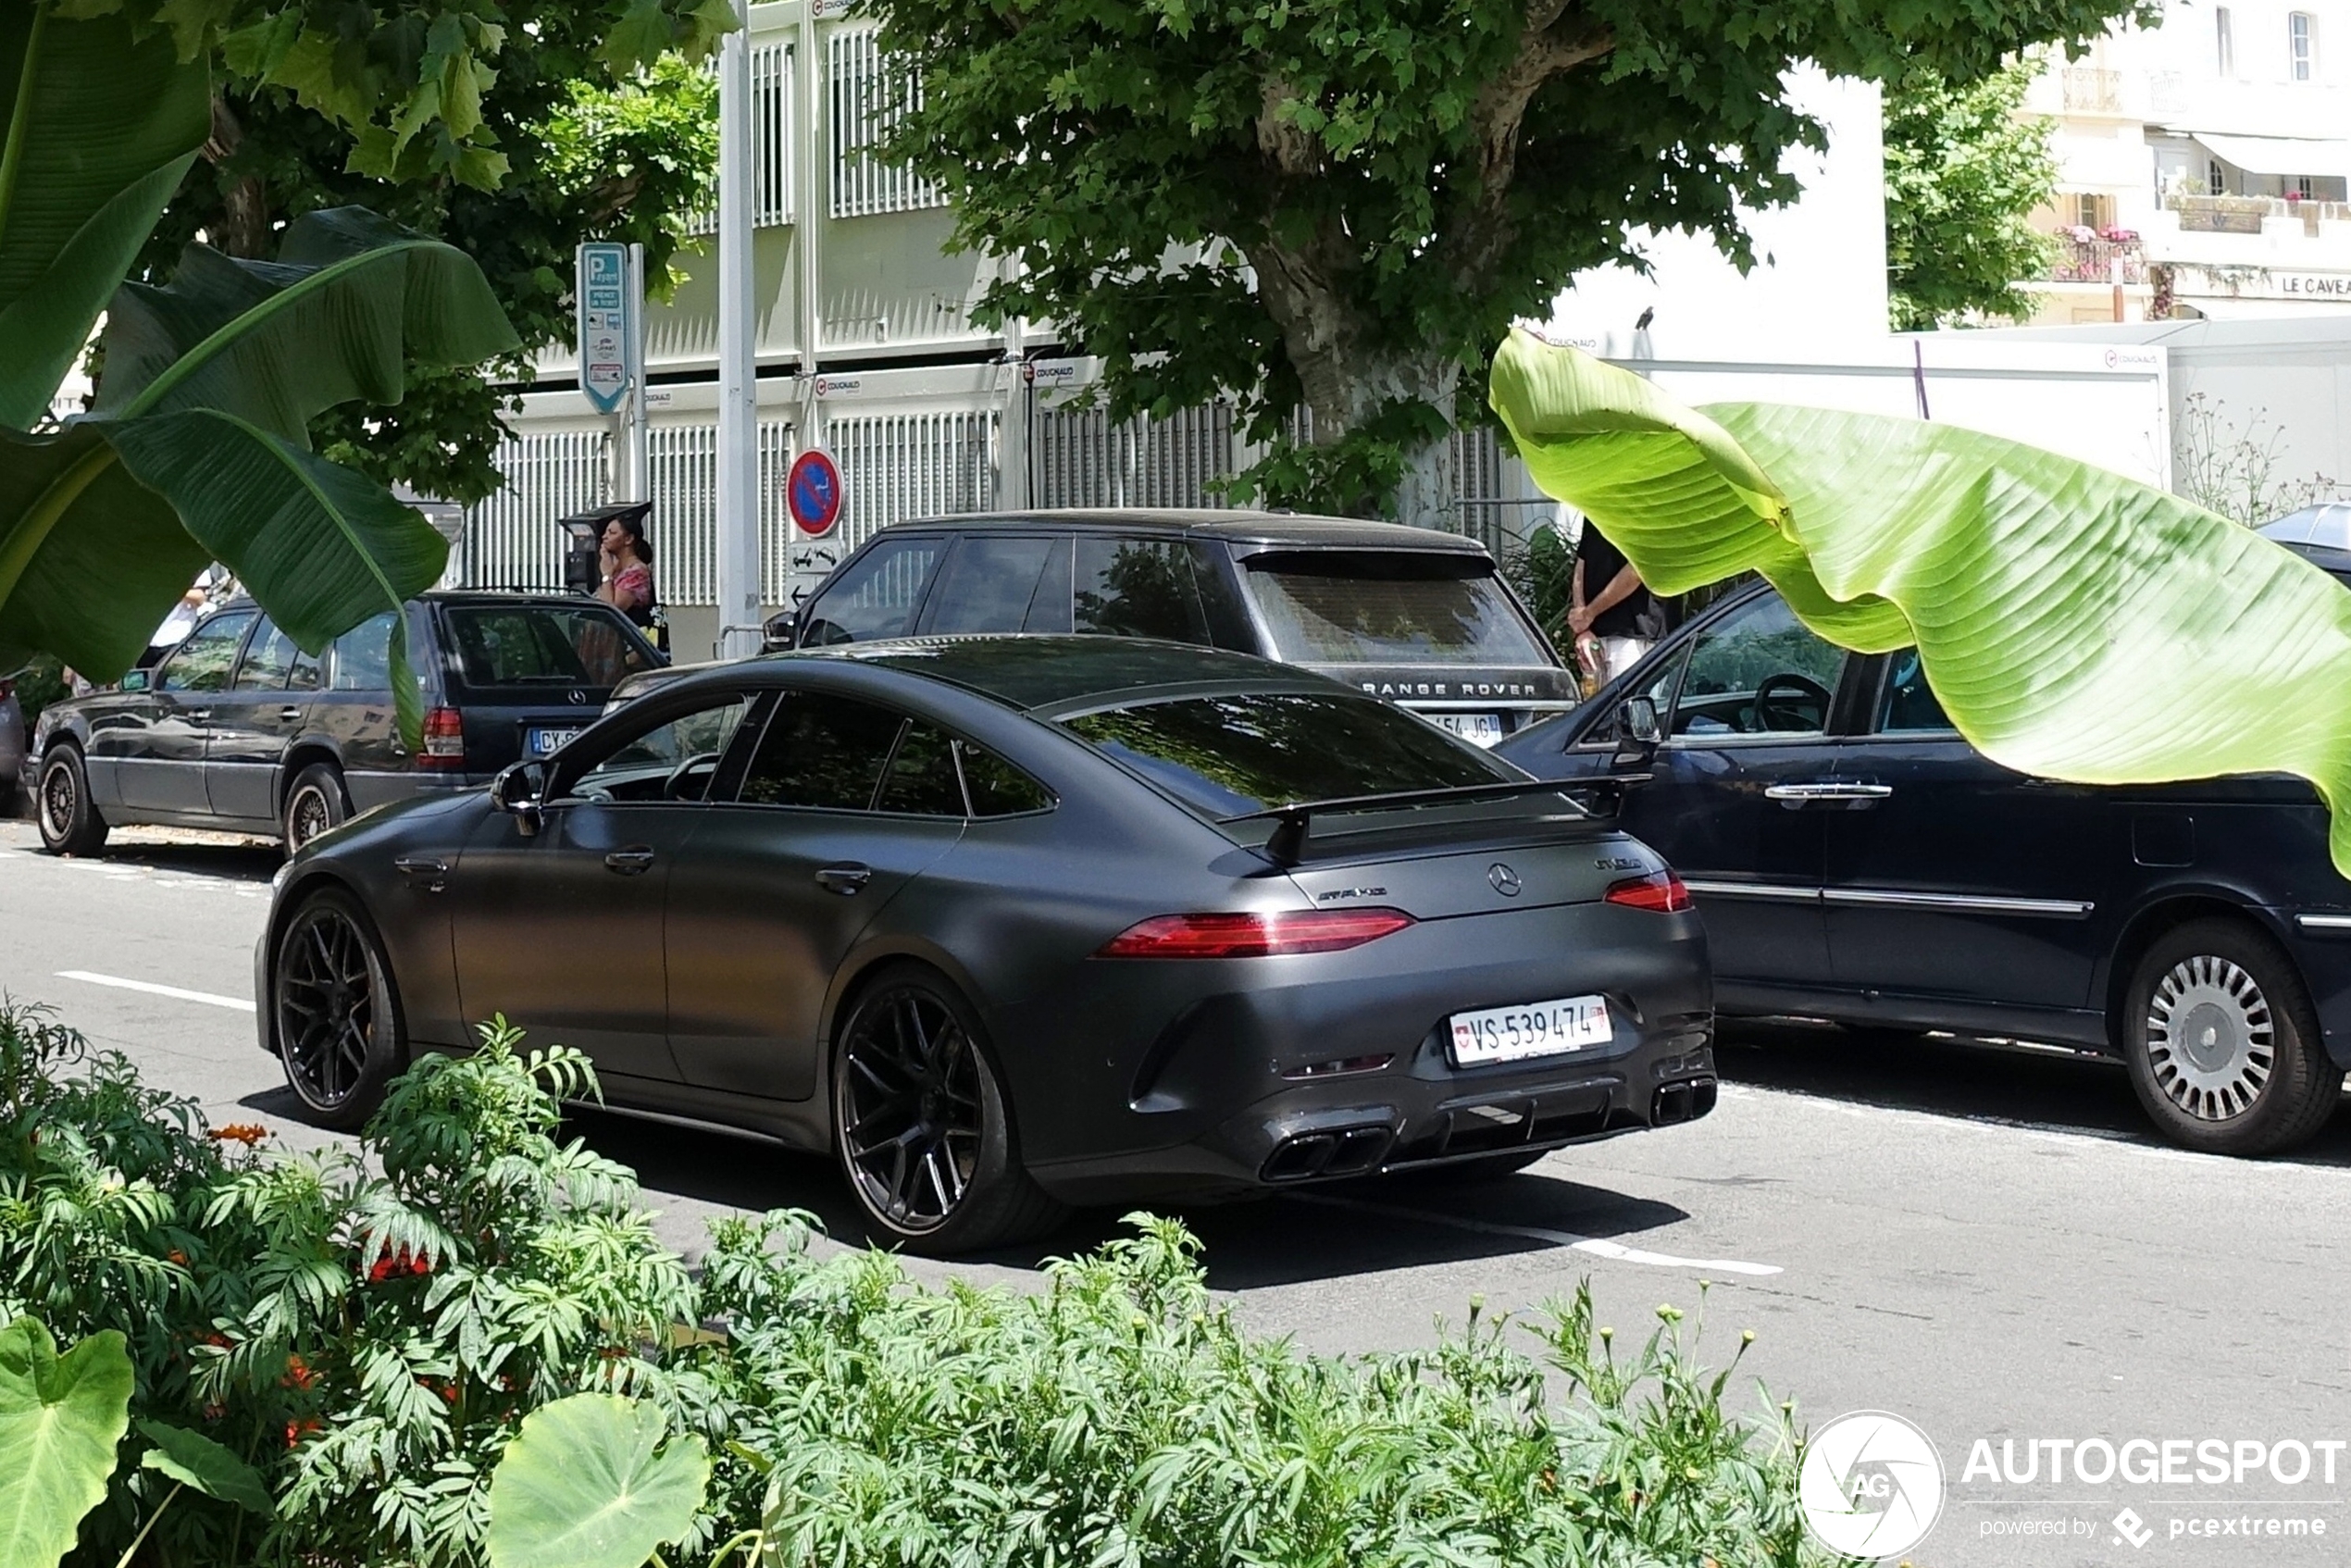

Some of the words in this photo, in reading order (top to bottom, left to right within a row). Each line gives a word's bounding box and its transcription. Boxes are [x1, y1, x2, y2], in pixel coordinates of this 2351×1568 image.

[2283, 277, 2299, 292] LE
[1362, 683, 1447, 695] RANGE
[1462, 684, 1536, 695] ROVER
